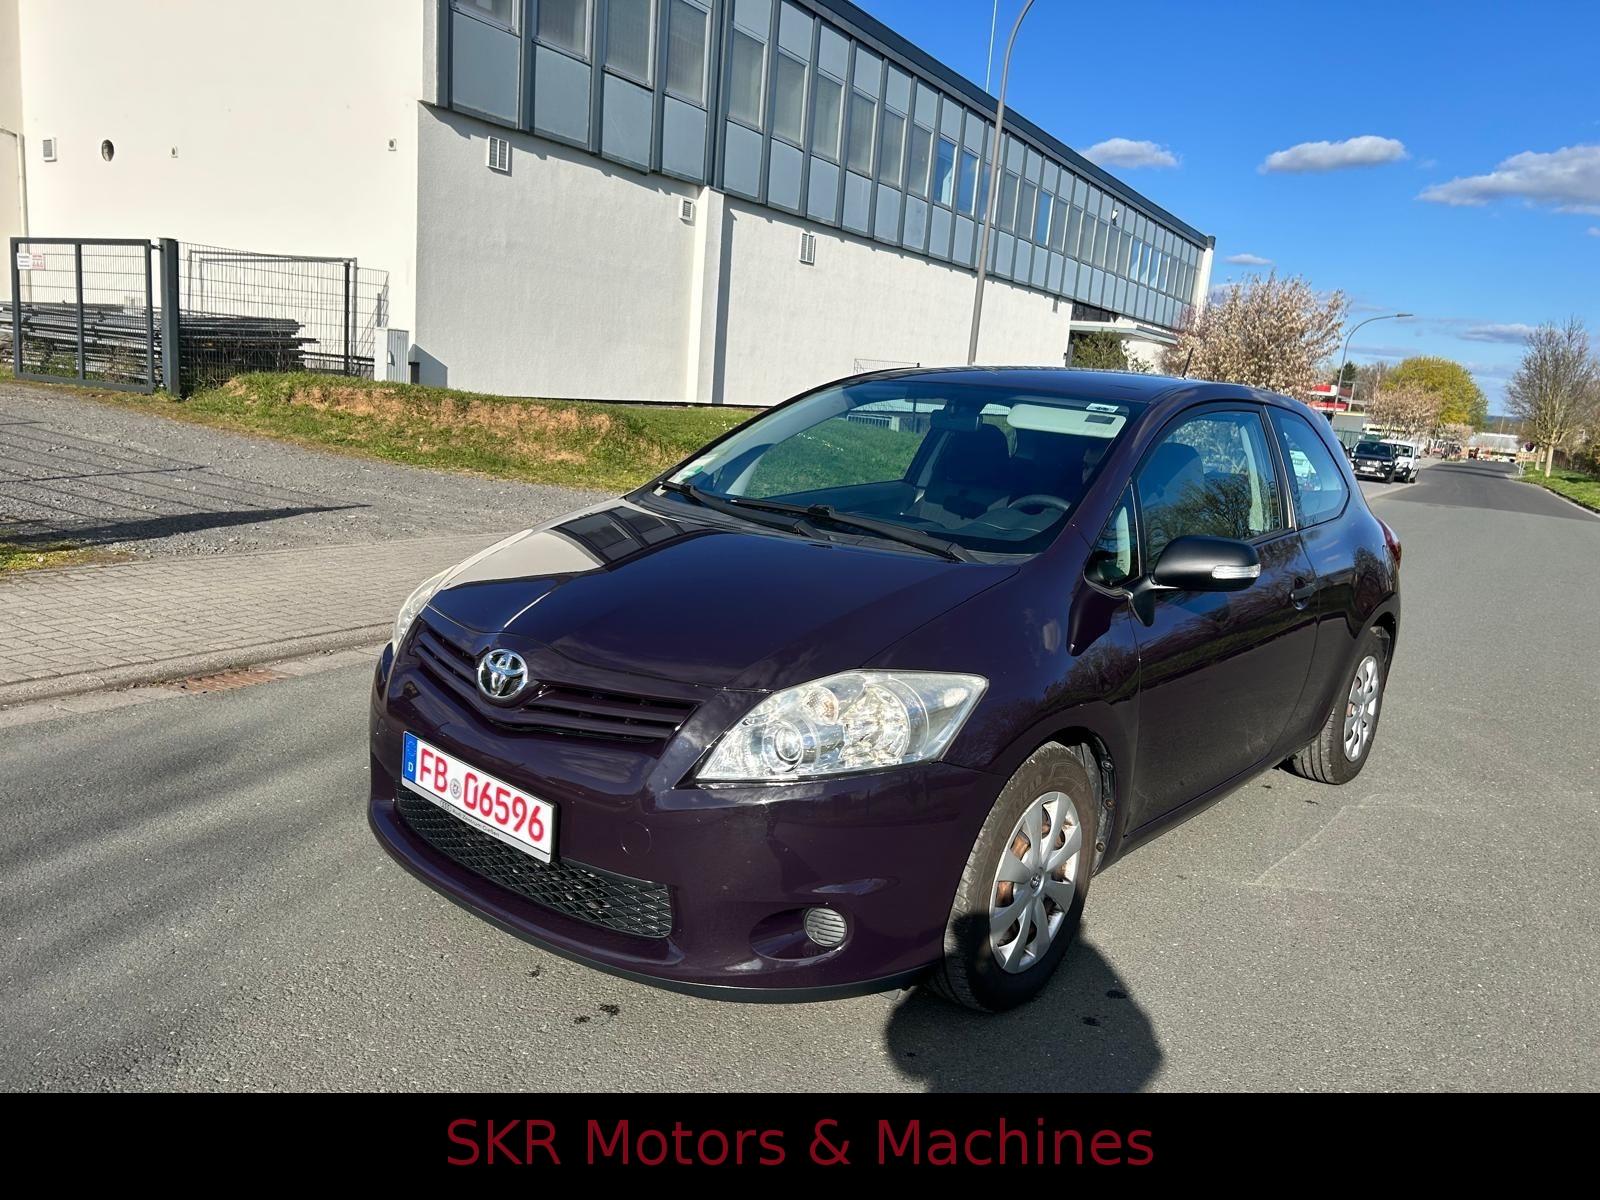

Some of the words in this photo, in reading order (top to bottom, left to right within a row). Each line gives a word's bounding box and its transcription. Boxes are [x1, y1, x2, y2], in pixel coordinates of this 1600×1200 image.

[407, 761, 414, 772] D
[420, 748, 448, 793] FB
[463, 771, 544, 842] 06596
